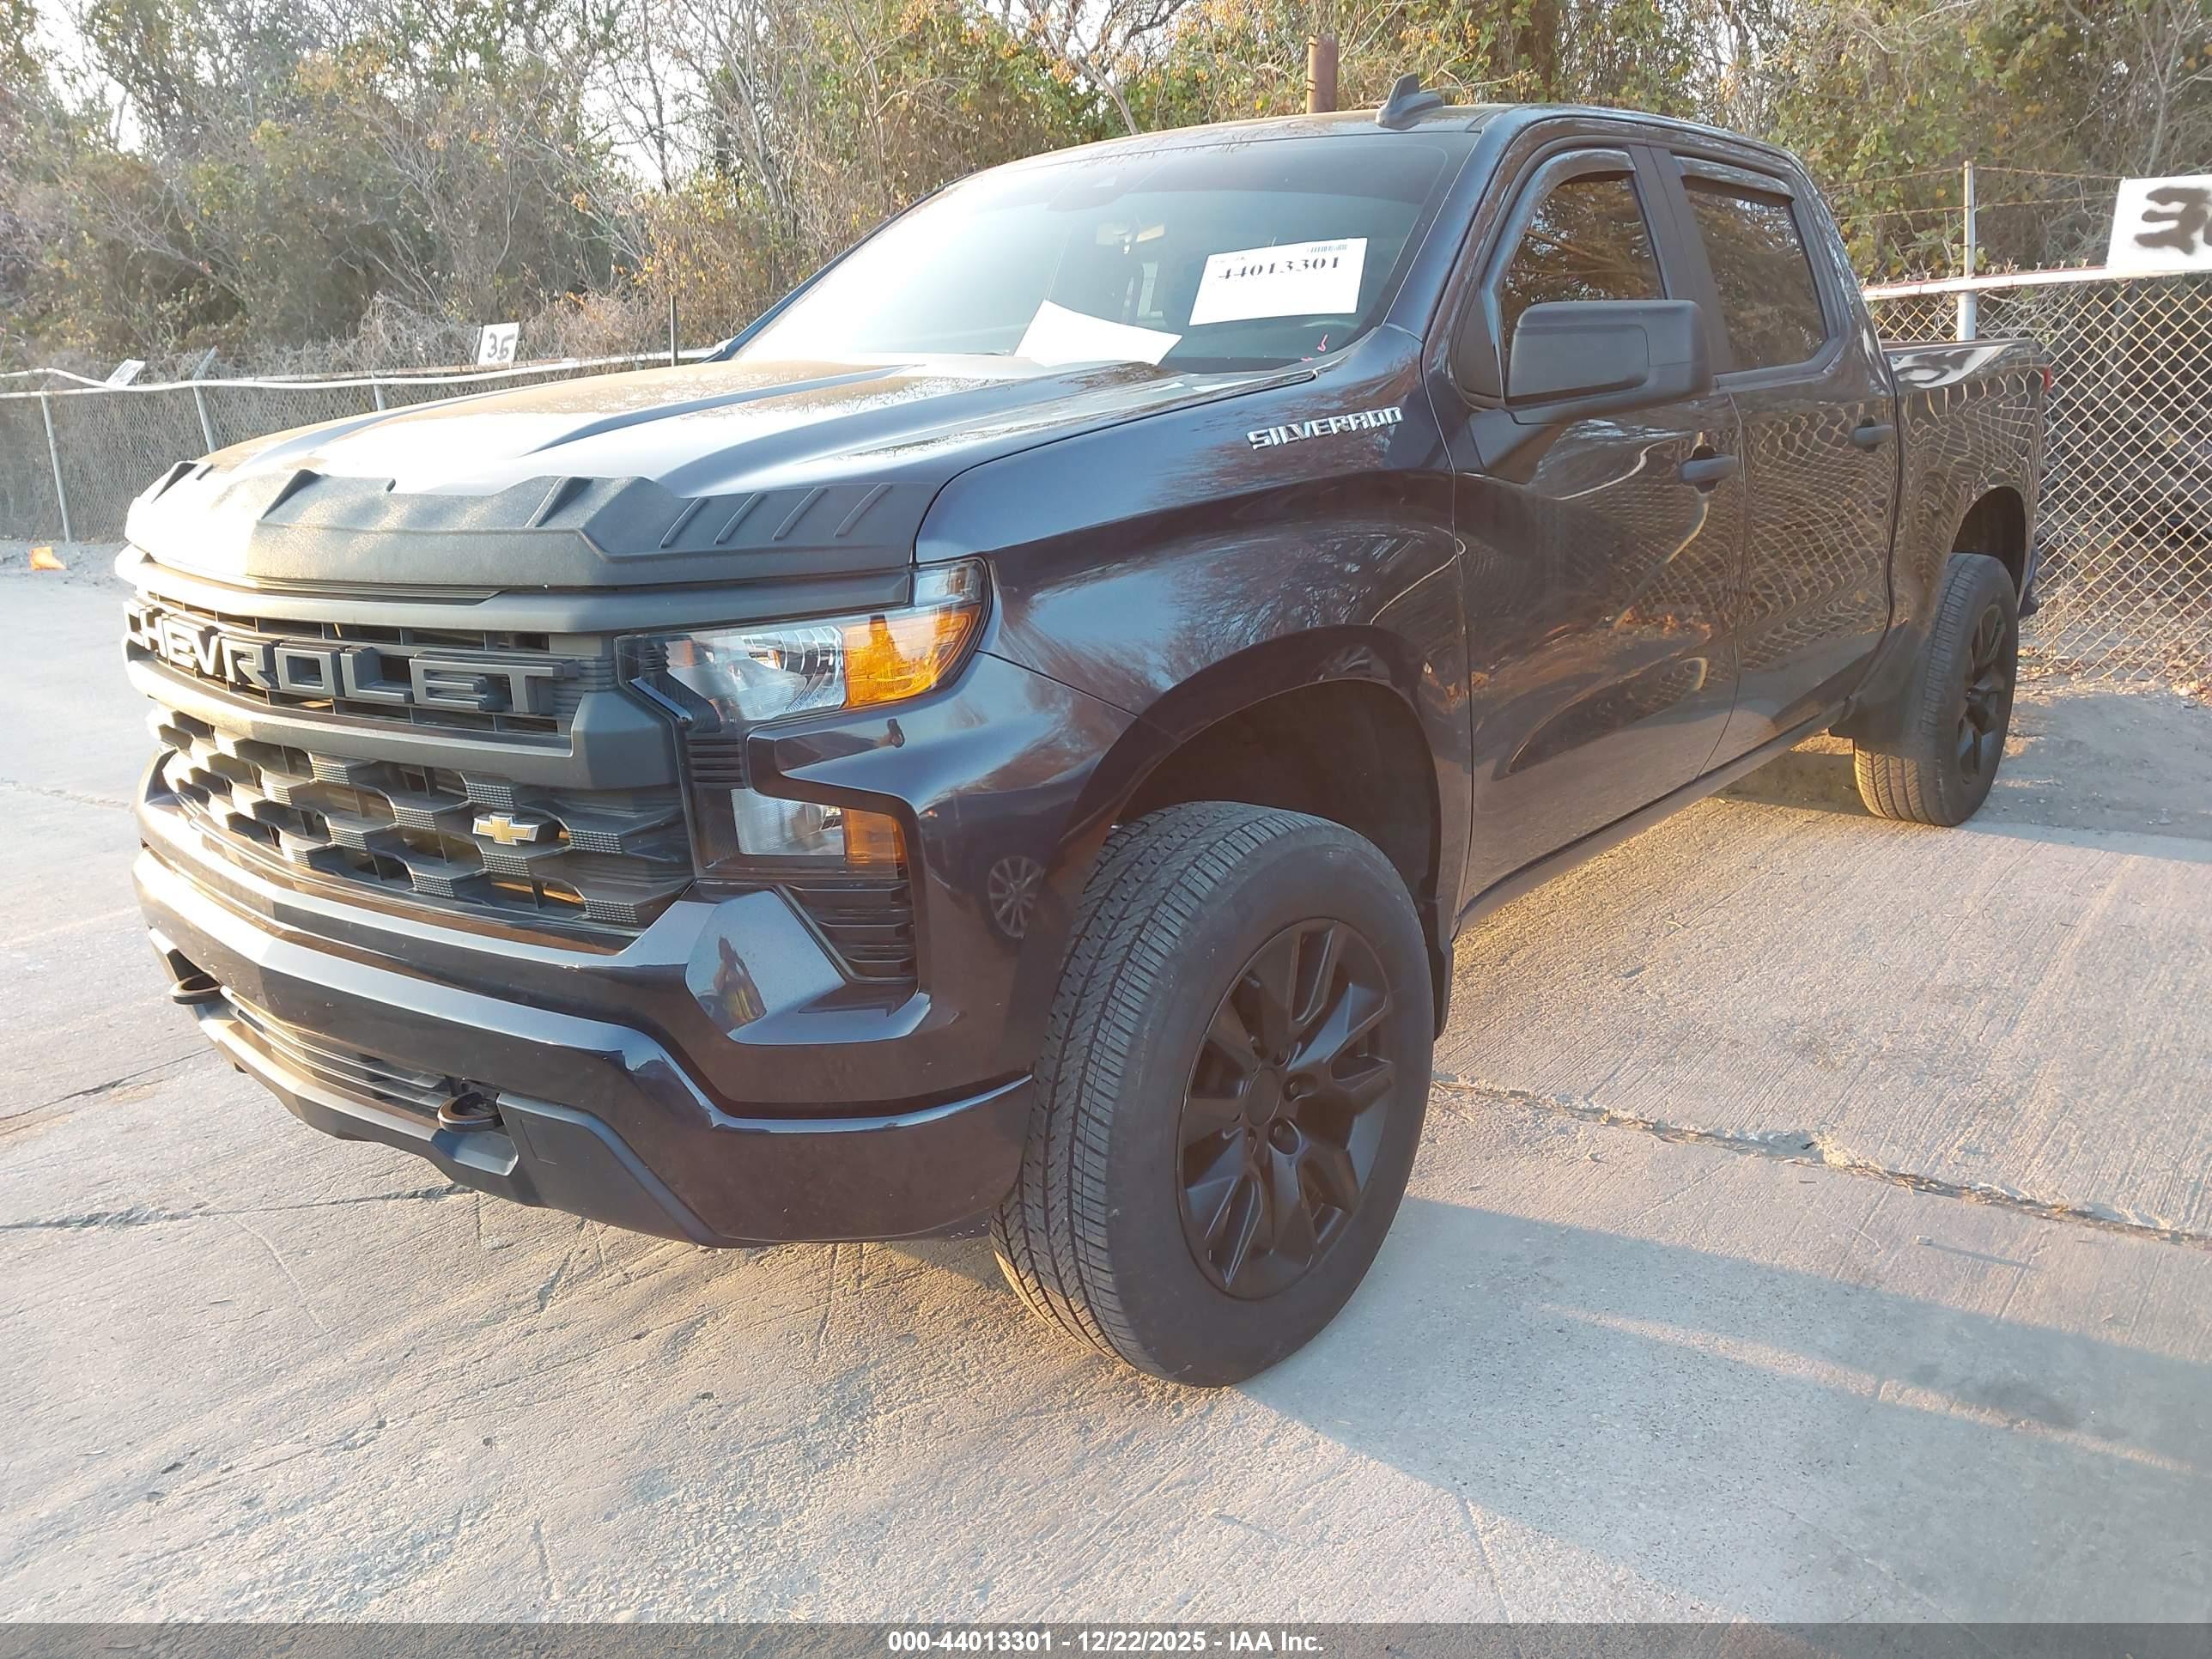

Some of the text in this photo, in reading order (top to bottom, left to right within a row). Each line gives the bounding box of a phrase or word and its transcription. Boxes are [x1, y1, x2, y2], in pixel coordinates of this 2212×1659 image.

[1218, 257, 1340, 280] 44013301
[1246, 406, 1403, 451] SILVERADO
[122, 598, 567, 714] CHEVROLET
